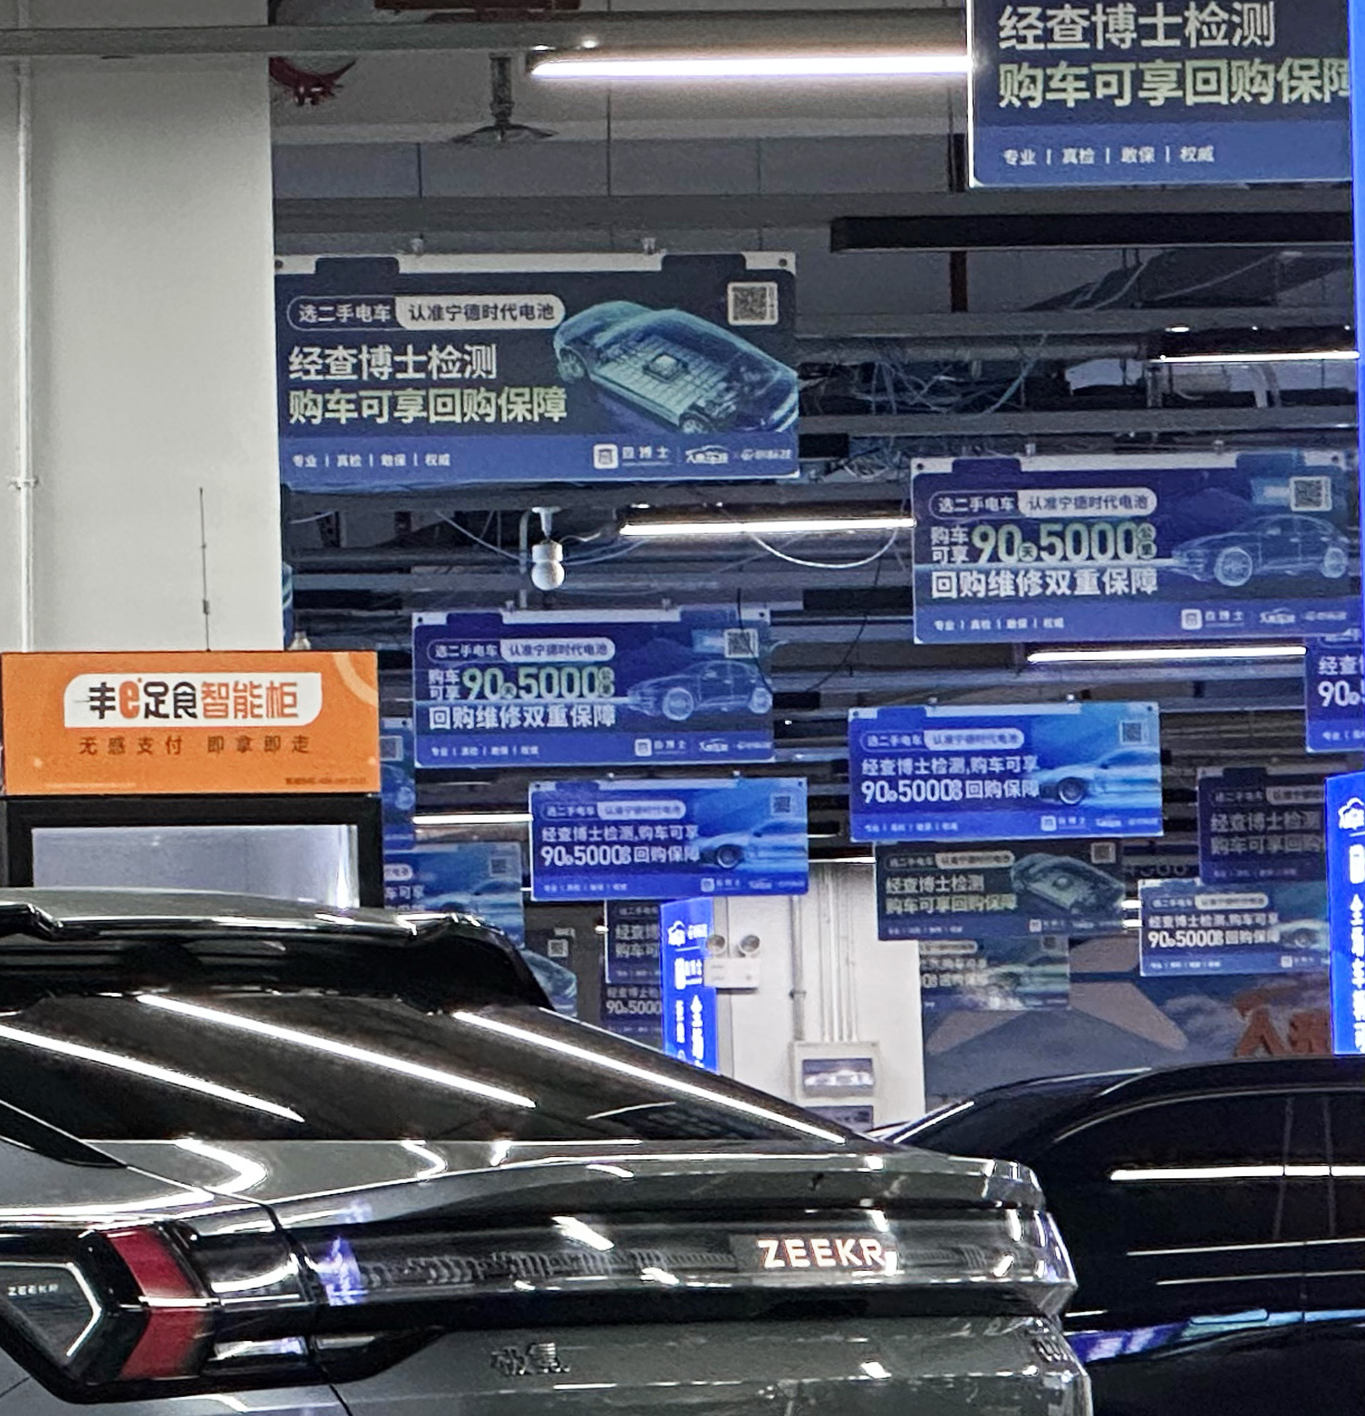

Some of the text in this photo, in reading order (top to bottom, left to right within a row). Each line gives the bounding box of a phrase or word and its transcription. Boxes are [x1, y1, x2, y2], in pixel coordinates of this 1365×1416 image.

[998, 1, 1275, 51] 经查博士检测
[1002, 149, 1036, 166] 专业
[298, 302, 555, 324] 选二手电车 认准宁德时代电池
[288, 343, 497, 381] 经查博士检测
[288, 386, 567, 425] 购车可享回购保障
[930, 568, 1158, 600] 回购维修双重保障
[429, 703, 616, 731] 回购维修双重保障
[79, 733, 311, 756] 无感支付 即拿即走
[757, 1237, 893, 1270] ZEEKR
[7, 1283, 59, 1296] ZEEKR
